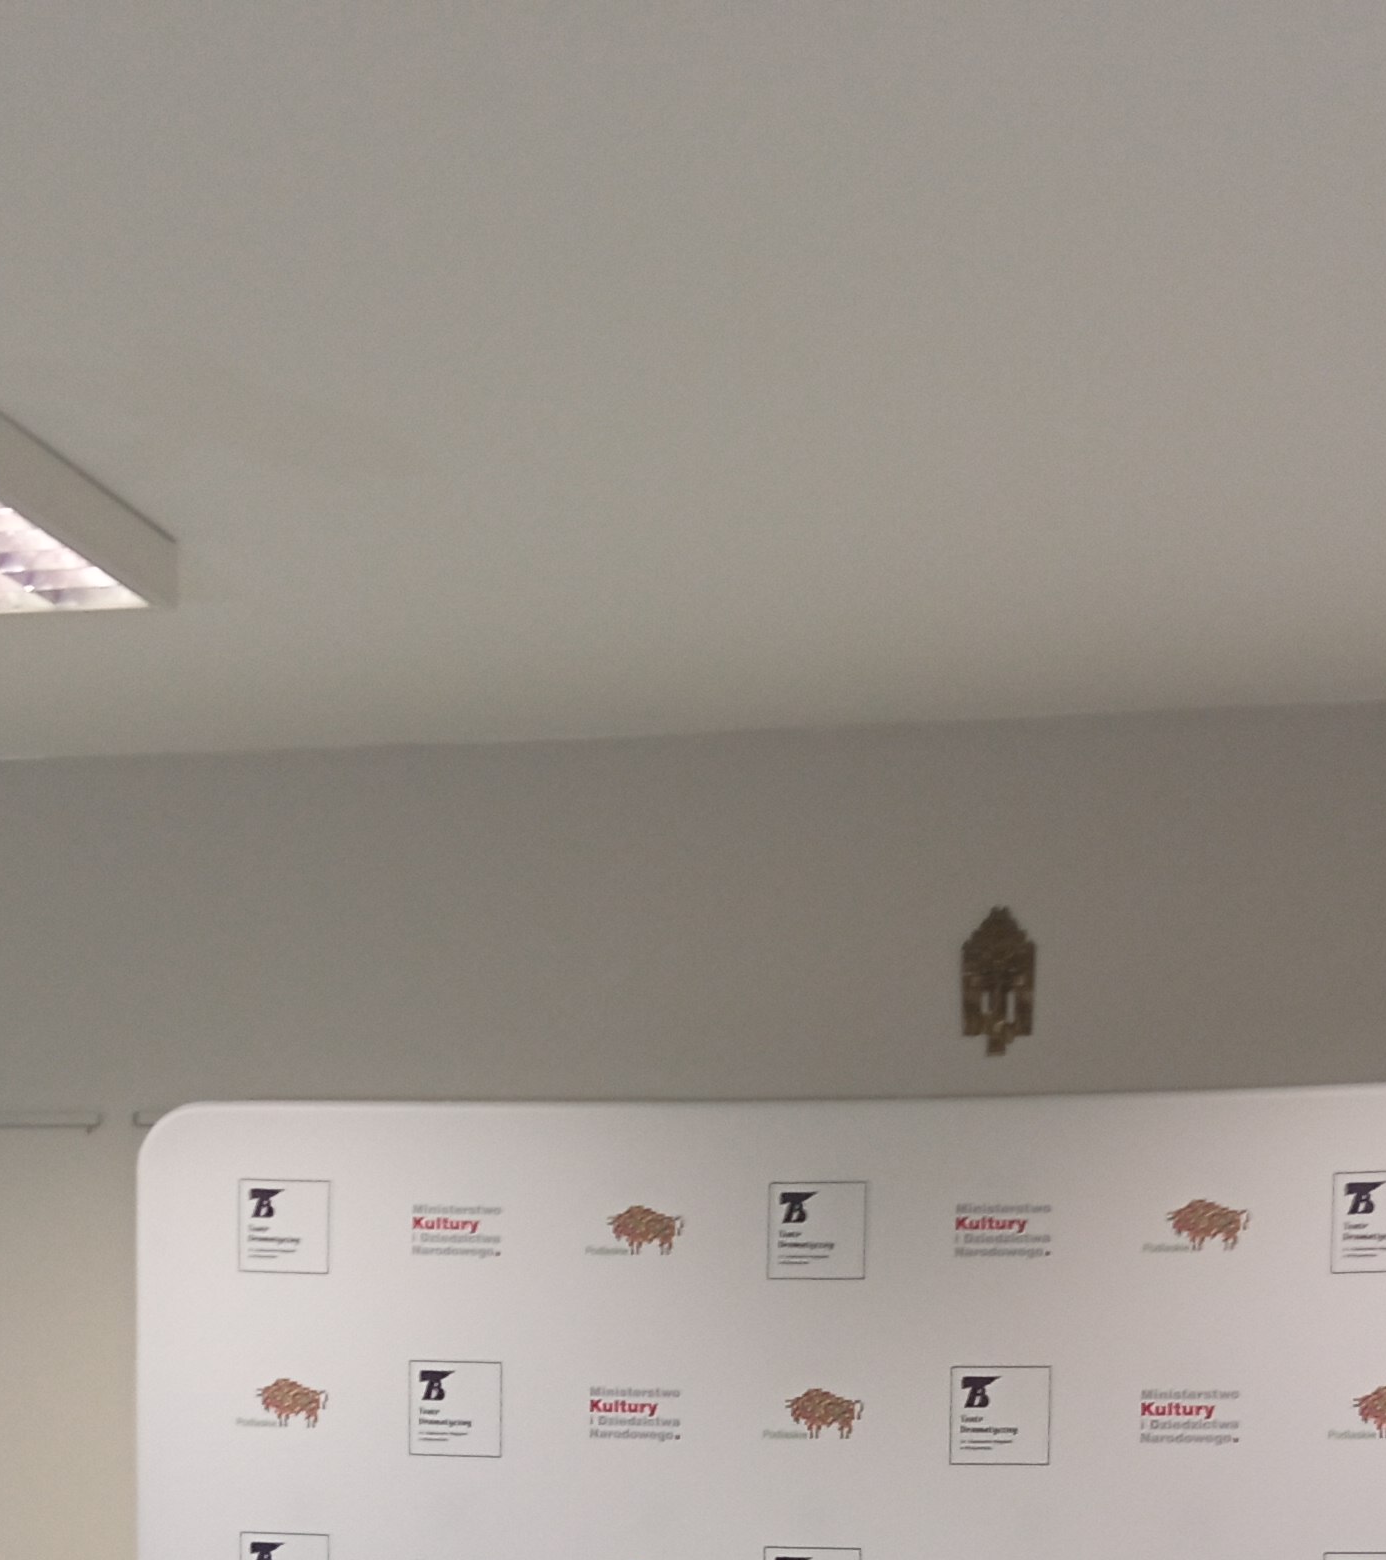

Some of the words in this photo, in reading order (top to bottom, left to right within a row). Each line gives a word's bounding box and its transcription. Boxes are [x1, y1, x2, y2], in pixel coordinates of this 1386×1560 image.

[412, 1216, 480, 1234] Kultury
[955, 1216, 1028, 1233] Kultury
[589, 1399, 658, 1417] Kultury
[1140, 1402, 1215, 1419] Kultury
